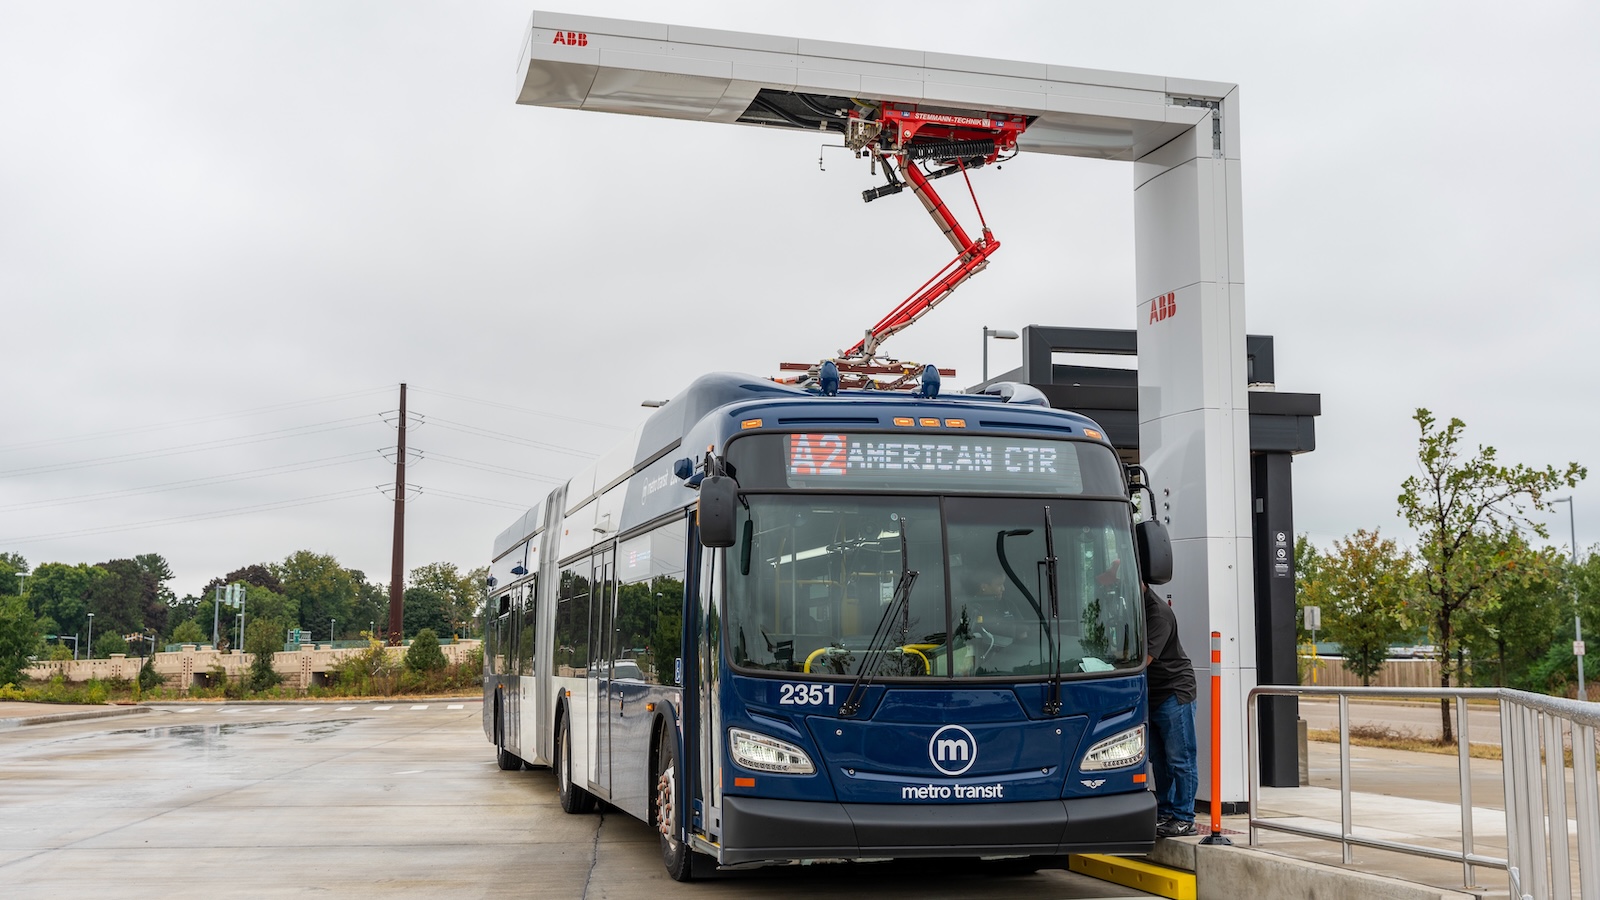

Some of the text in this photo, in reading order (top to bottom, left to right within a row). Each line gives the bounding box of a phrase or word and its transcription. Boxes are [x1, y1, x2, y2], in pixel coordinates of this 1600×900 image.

[553, 31, 588, 47] ABB
[914, 112, 982, 125] STEMMANN-TECHNIK
[1150, 292, 1176, 325] ABB
[791, 434, 1057, 475] A2 AMERICAN CTR
[779, 684, 835, 705] 2351
[938, 739, 969, 761] m
[902, 783, 1003, 799] metro transit
